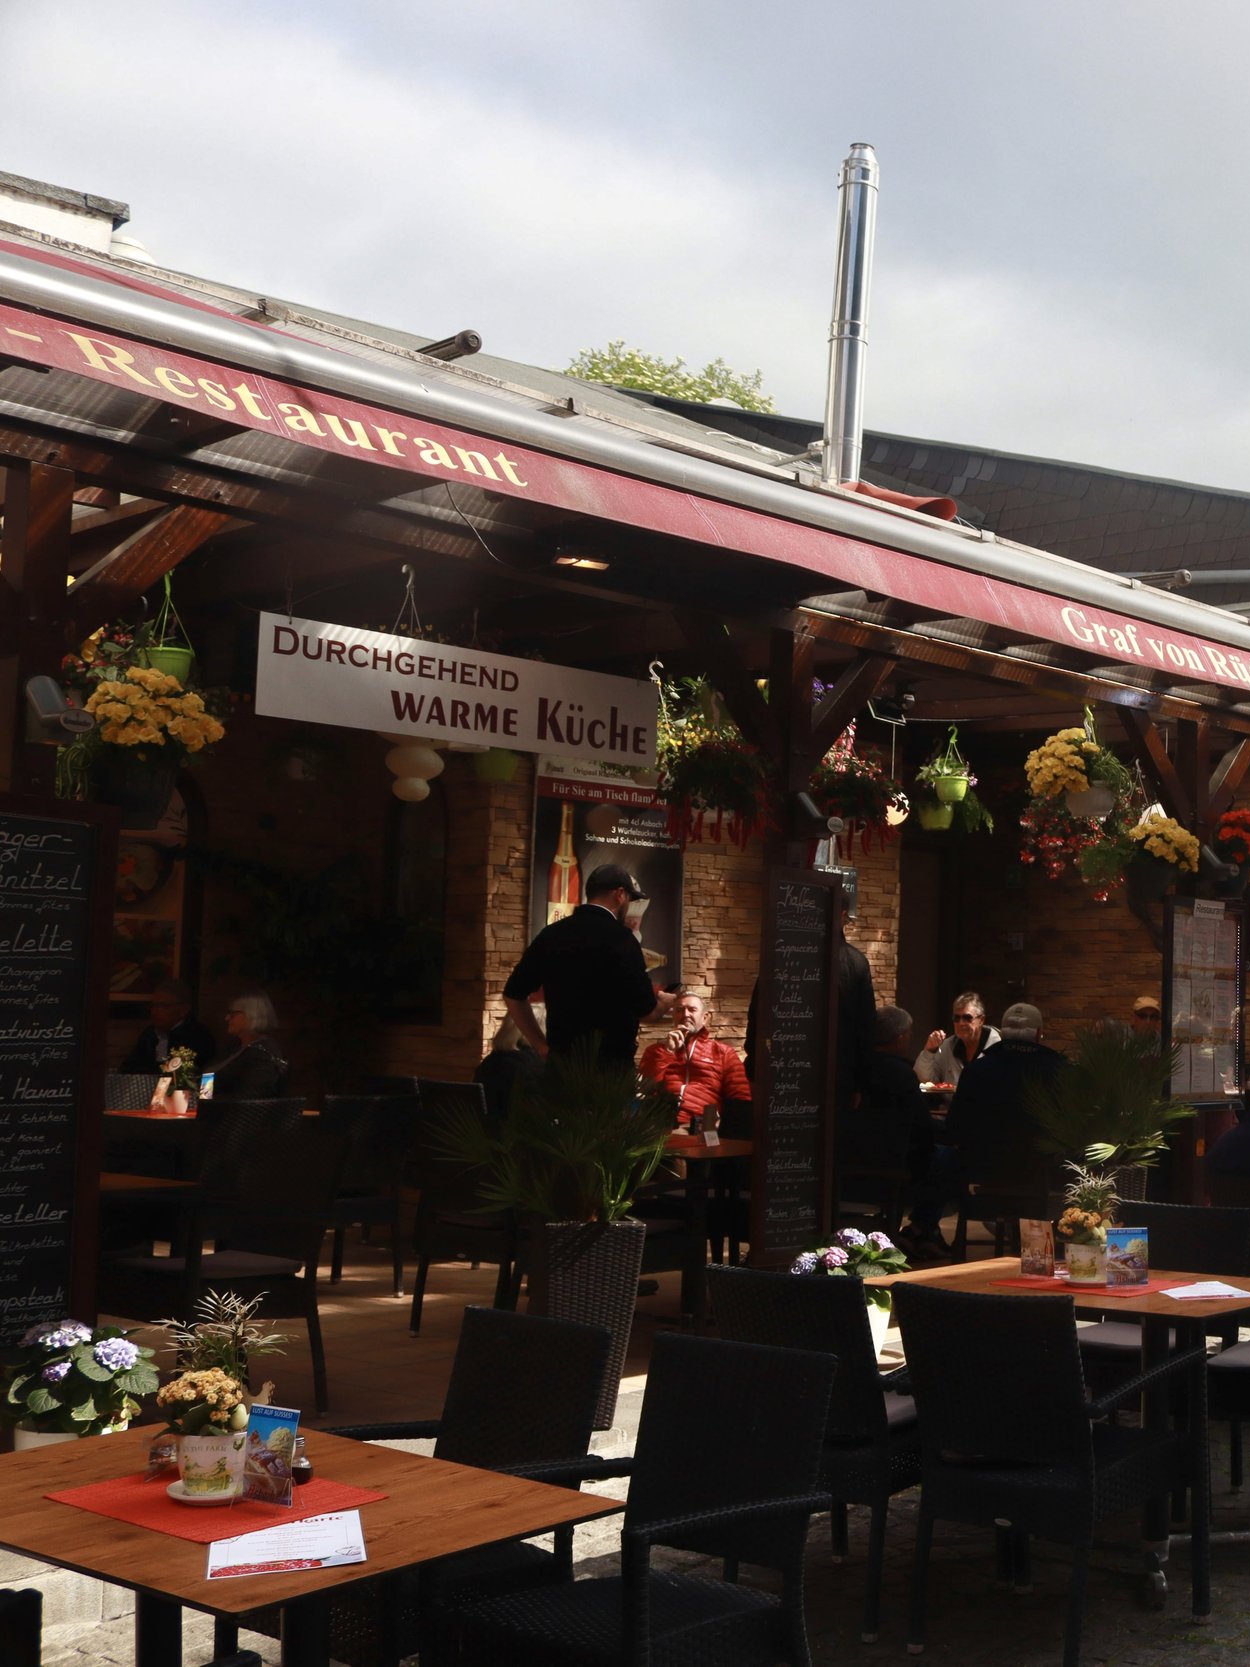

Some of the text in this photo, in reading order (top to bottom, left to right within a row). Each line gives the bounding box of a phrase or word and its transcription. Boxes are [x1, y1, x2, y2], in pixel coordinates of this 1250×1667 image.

[60, 329, 529, 488] Restaurant
[273, 624, 520, 693] DURCHGEHEND
[1061, 606, 1144, 658] Graf
[1145, 637, 1207, 673] von
[552, 781, 569, 795] Für
[571, 784, 587, 796] Sie
[588, 789, 603, 799] am
[604, 788, 629, 801] Tisch
